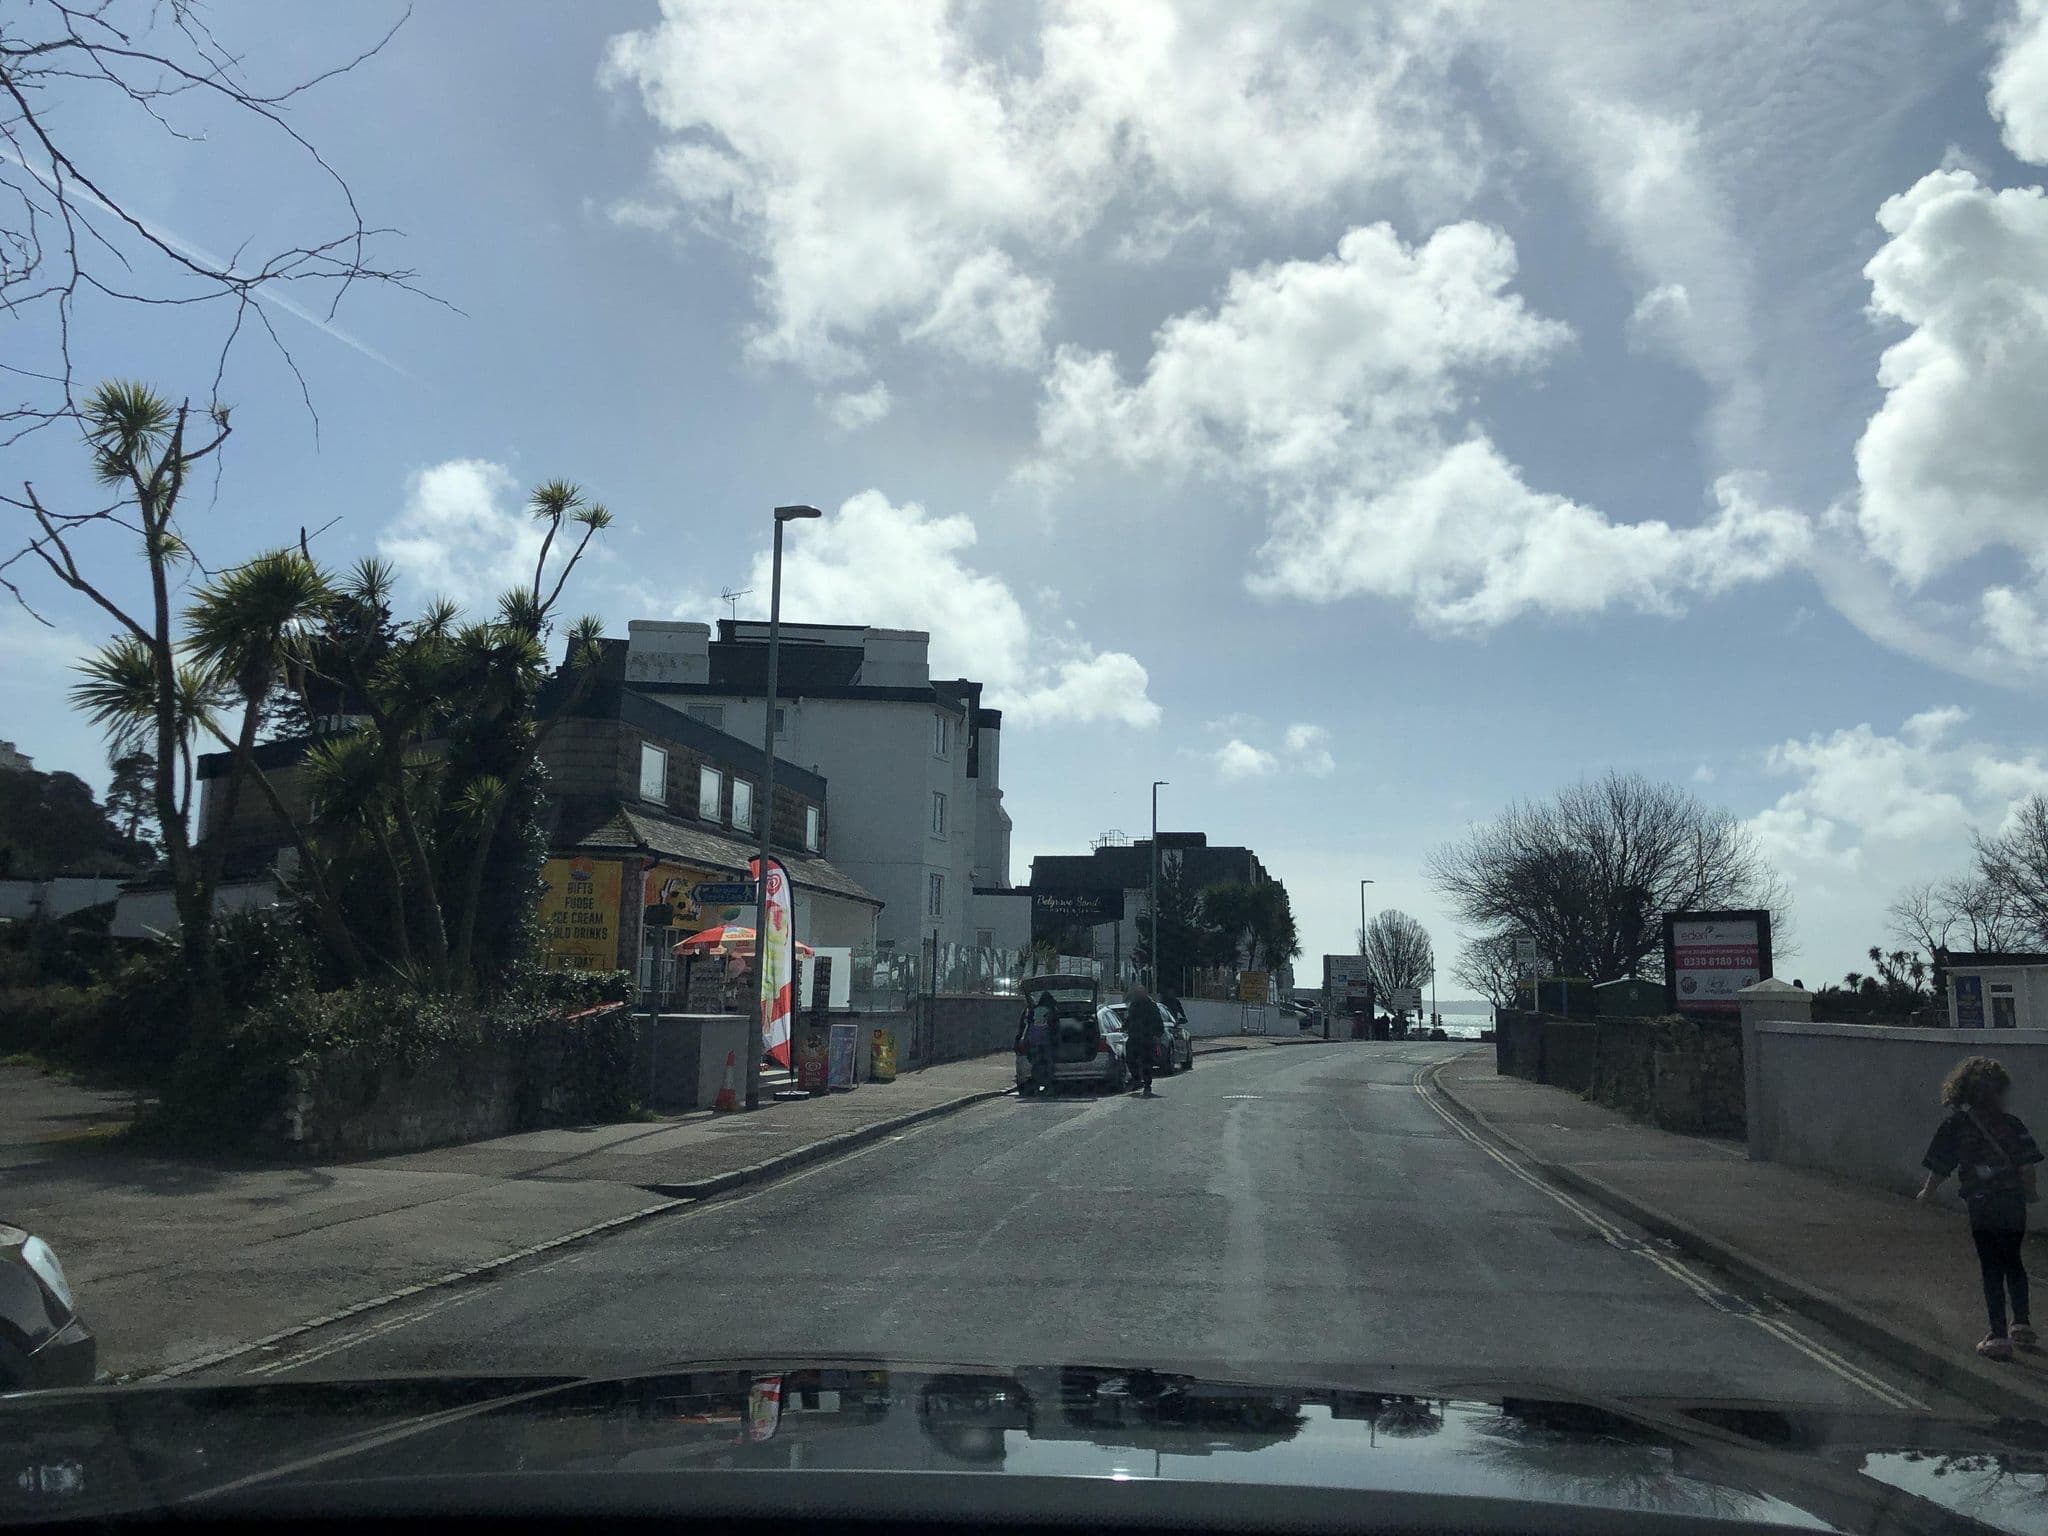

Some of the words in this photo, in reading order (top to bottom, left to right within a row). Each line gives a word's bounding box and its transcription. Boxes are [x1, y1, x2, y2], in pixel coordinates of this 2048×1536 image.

[567, 882, 593, 895] GIFTS
[565, 896, 594, 910] FUDGE
[571, 911, 604, 925] CREAM
[549, 926, 571, 939] OLD
[574, 926, 608, 941] DRINKS
[1683, 957, 1706, 966] 0330
[1709, 957, 1732, 966] 8180
[1735, 957, 1753, 966] 150
